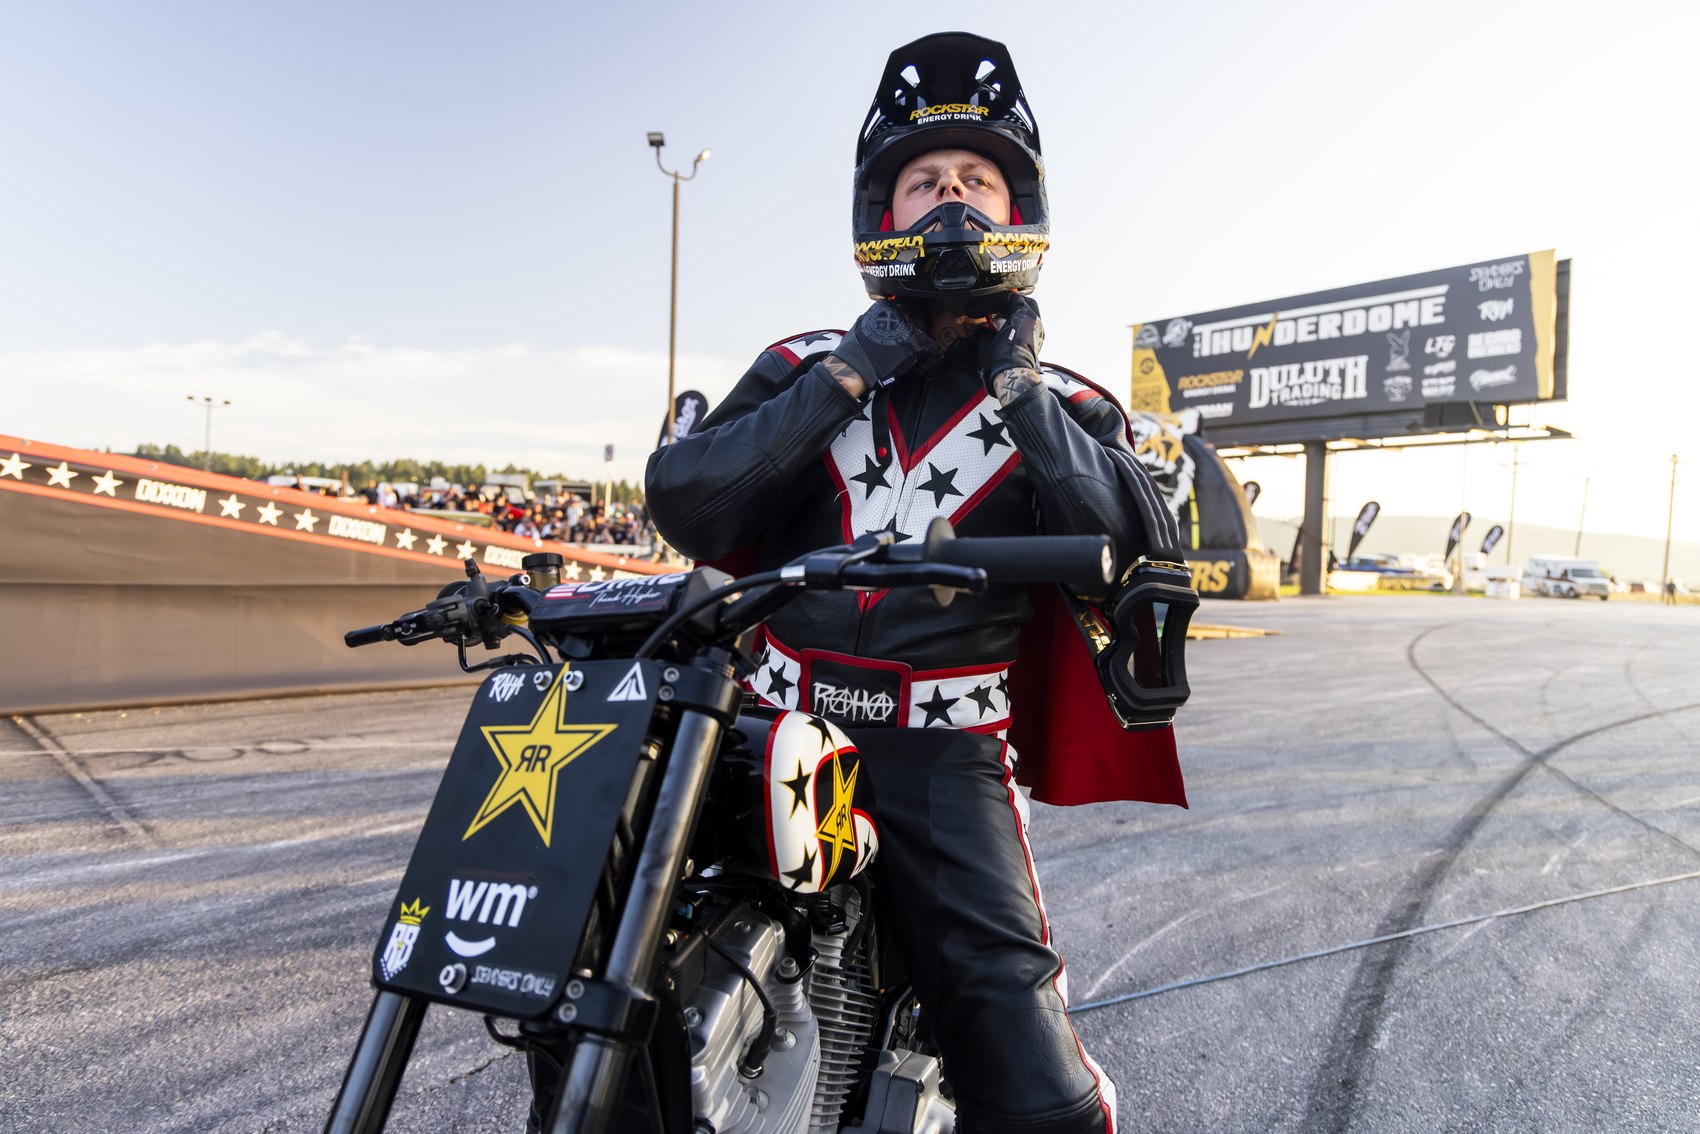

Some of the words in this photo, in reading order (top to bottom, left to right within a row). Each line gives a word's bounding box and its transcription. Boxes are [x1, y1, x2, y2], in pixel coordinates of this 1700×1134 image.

[909, 103, 989, 121] ROCKSTAR
[917, 113, 952, 125] ENERGY
[953, 113, 982, 121] DRINK
[889, 263, 916, 277] DRINK
[990, 260, 1021, 273] ENERGY
[1192, 285, 1450, 360] THUNDERDOME
[1248, 355, 1369, 409] DULUTH
[1270, 383, 1342, 406] TRADING
[134, 478, 207, 514] DIXXON
